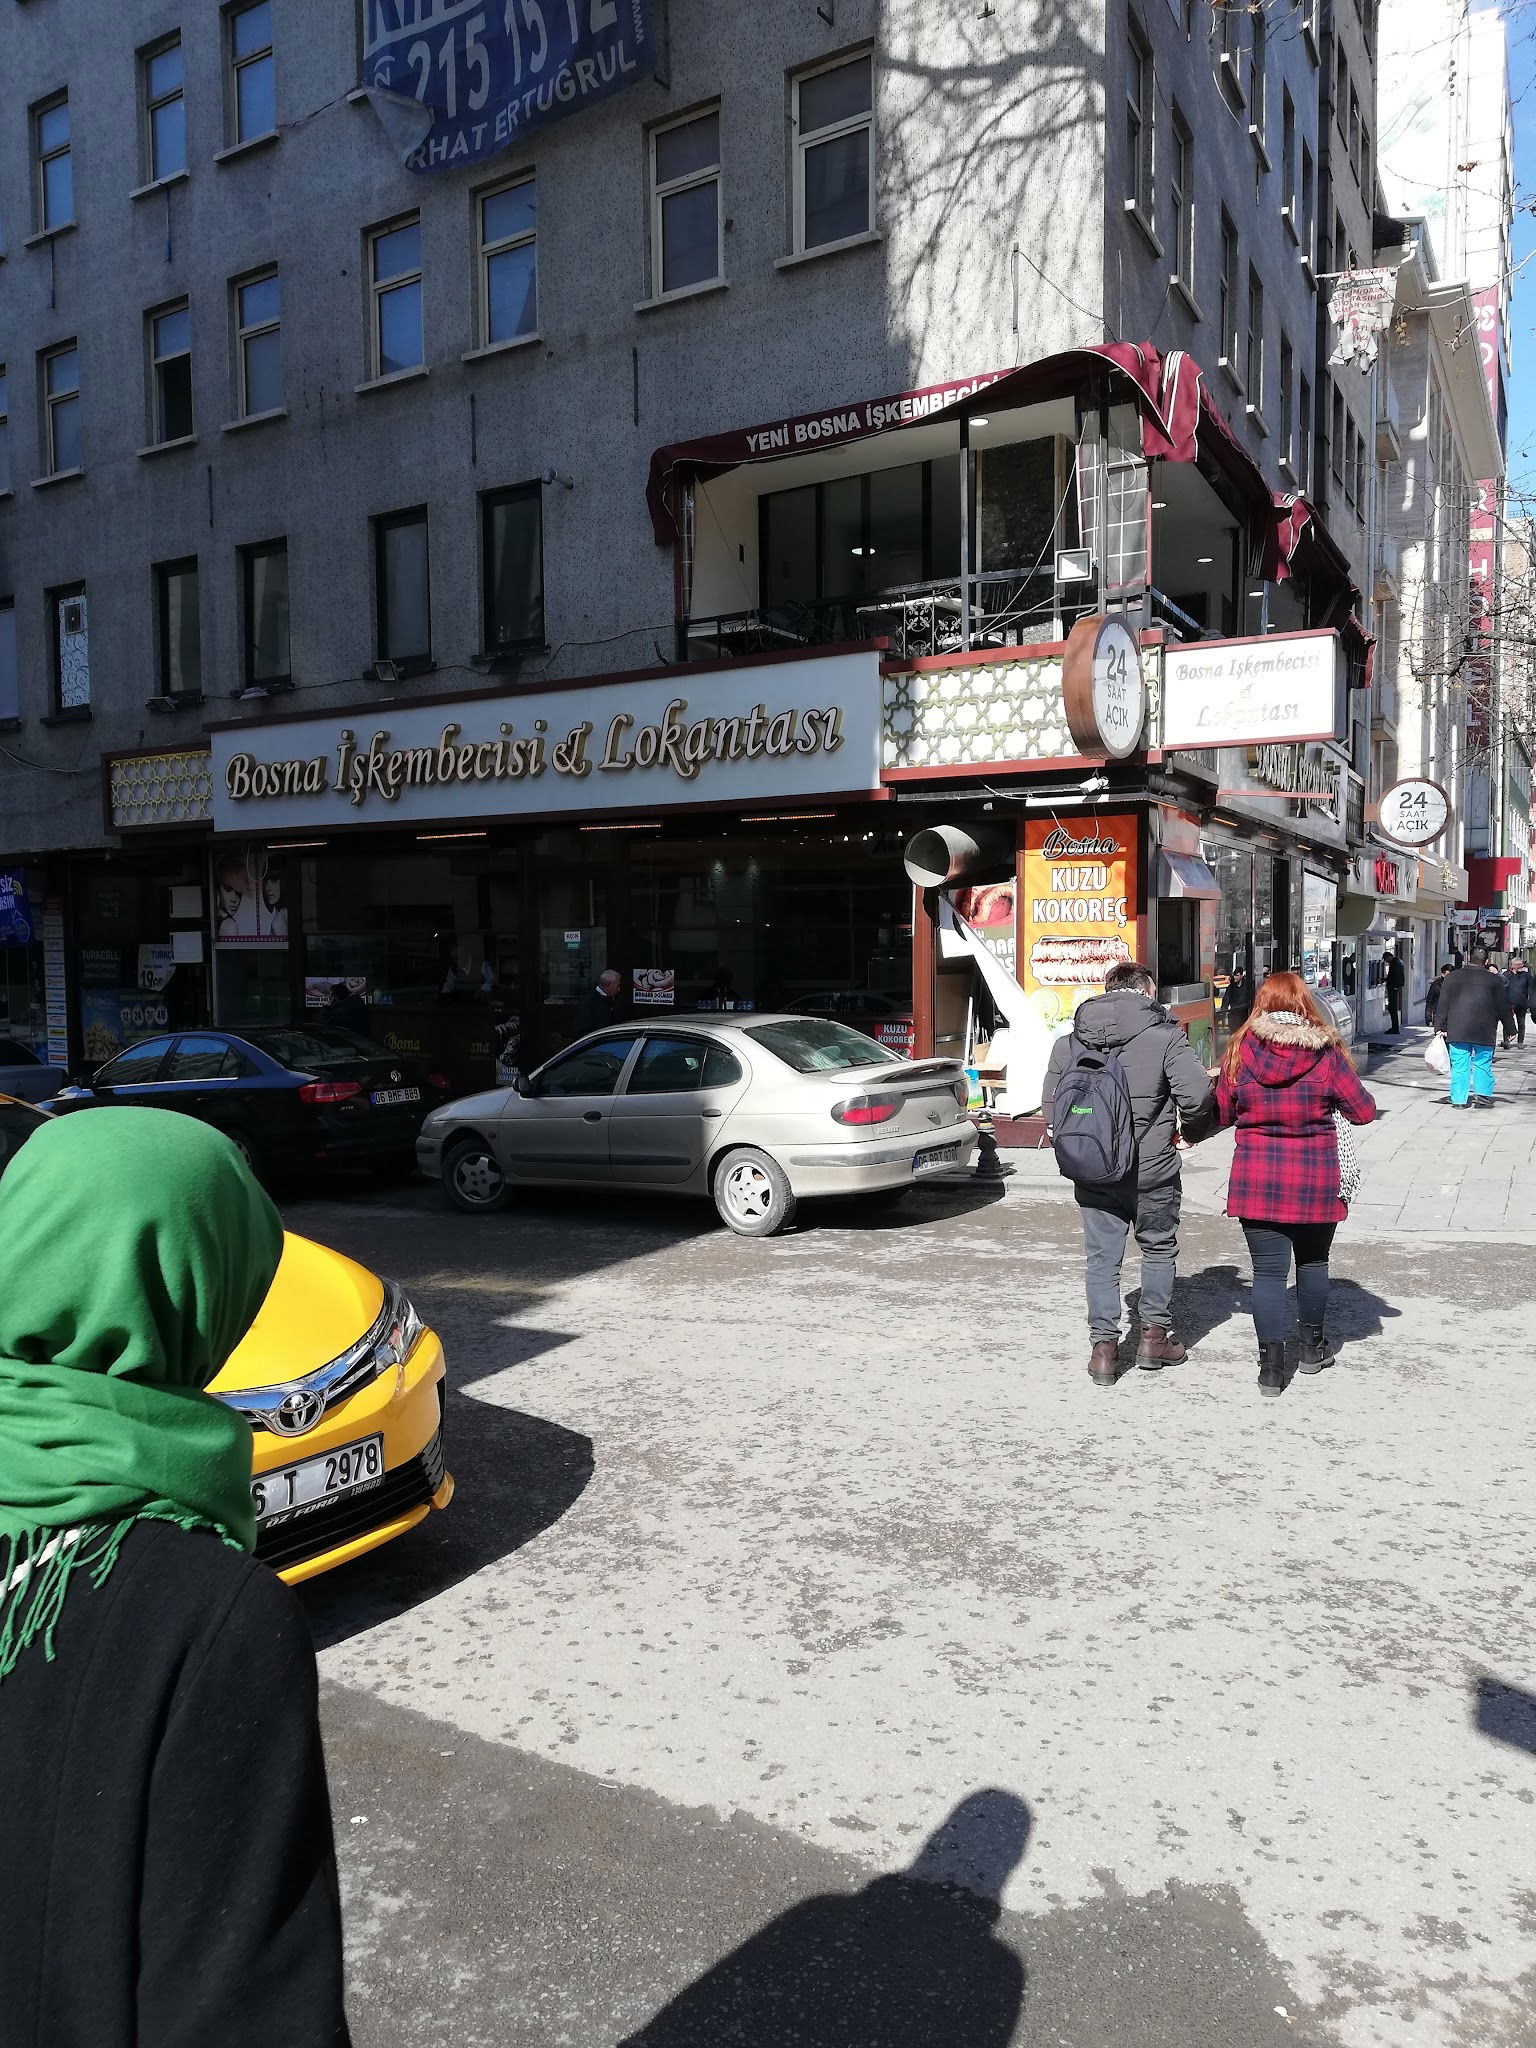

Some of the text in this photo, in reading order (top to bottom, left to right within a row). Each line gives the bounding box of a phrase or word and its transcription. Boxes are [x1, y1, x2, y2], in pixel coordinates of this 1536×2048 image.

[494, 40, 638, 143] ERTUĞRUL
[746, 427, 789, 453] YENİ
[794, 413, 860, 441] BOSNA
[1107, 644, 1127, 684] 24
[1176, 664, 1223, 681] Bosna
[1107, 684, 1126, 702] SAAT
[1105, 704, 1129, 730] AÇIK
[226, 698, 845, 806] Bosna İşkembecisi & Lokantası
[1399, 791, 1428, 808] 24
[1397, 820, 1429, 832] AÇIK
[1042, 828, 1120, 860] Bosna
[1051, 866, 1109, 892] KUZU
[1032, 897, 1128, 928] KOKOREÇ
[883, 1024, 907, 1033] KUZU
[283, 1470, 297, 1505] T
[325, 1443, 378, 1492] 2978
